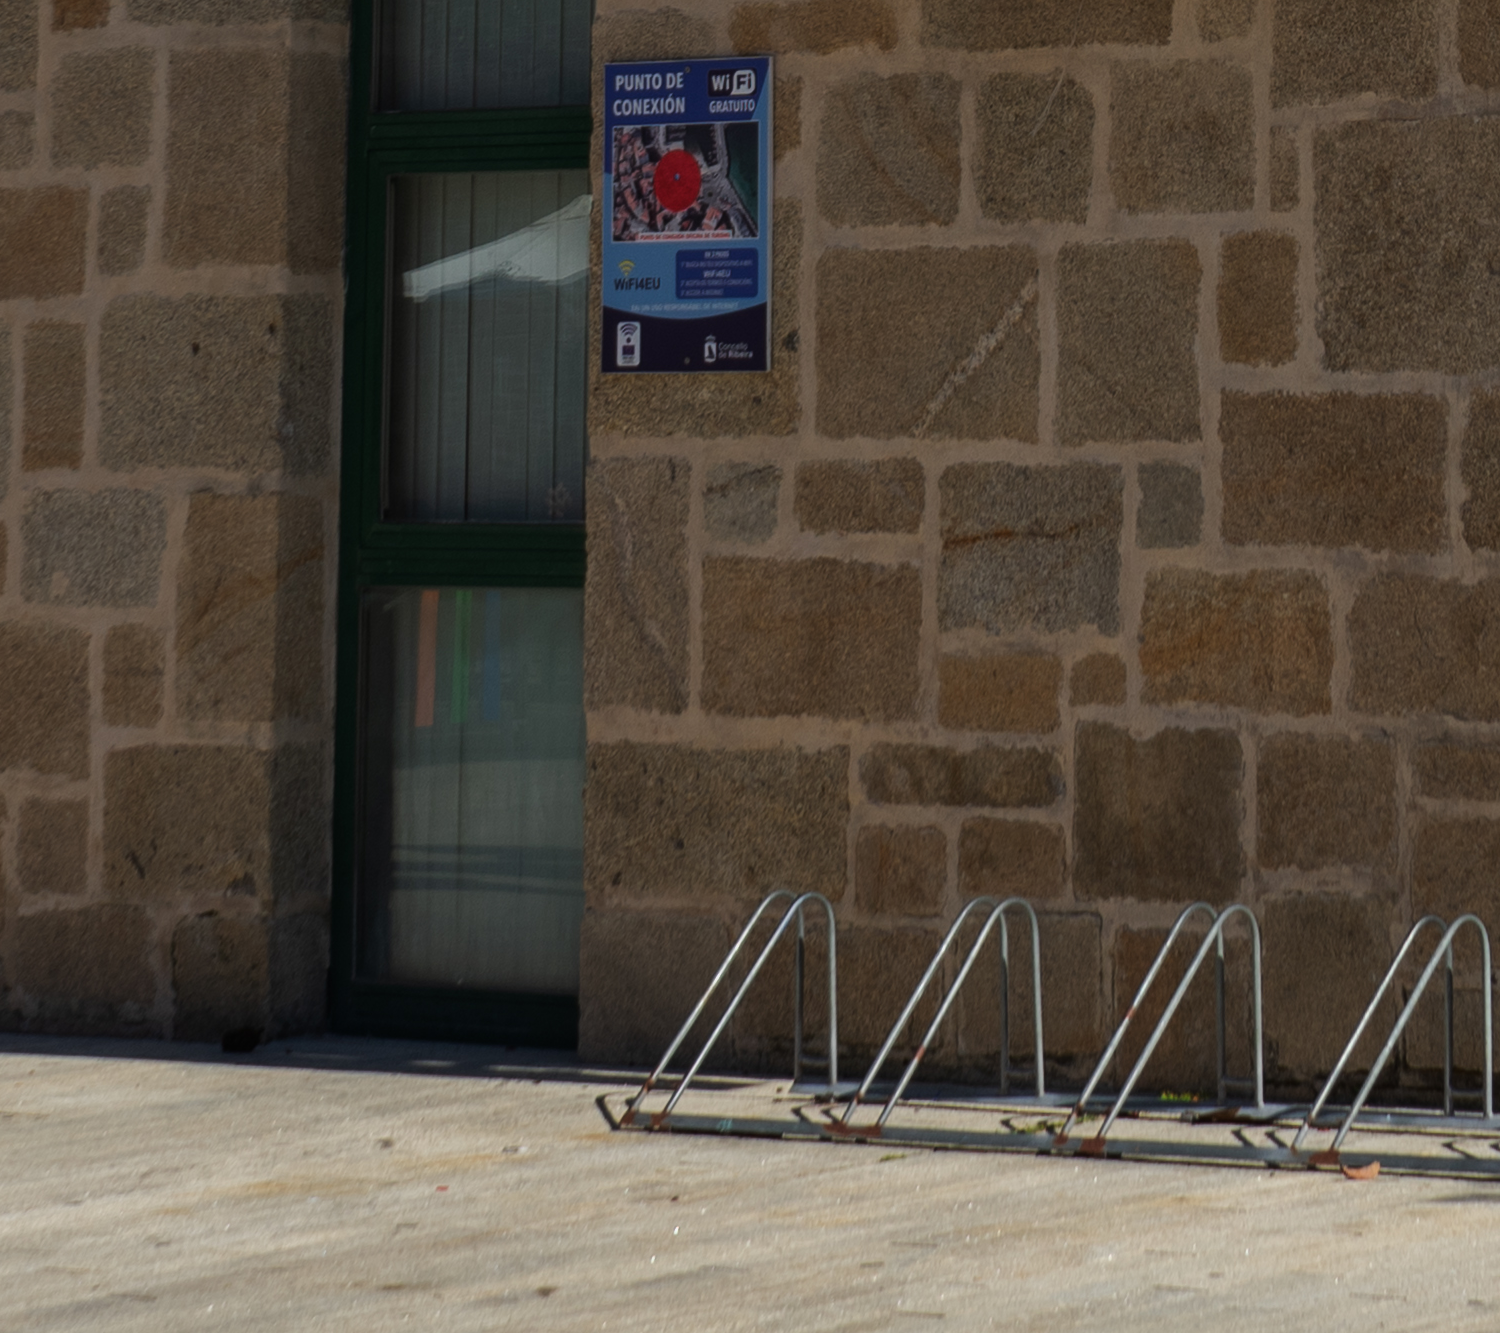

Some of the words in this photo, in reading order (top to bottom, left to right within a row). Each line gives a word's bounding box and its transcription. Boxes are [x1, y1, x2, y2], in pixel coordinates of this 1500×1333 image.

[614, 73, 662, 92] PUNTO
[666, 72, 684, 89] DE
[711, 74, 753, 92] WiFi
[613, 93, 685, 116] CONEXIÓN
[709, 99, 756, 113] GRATUITO
